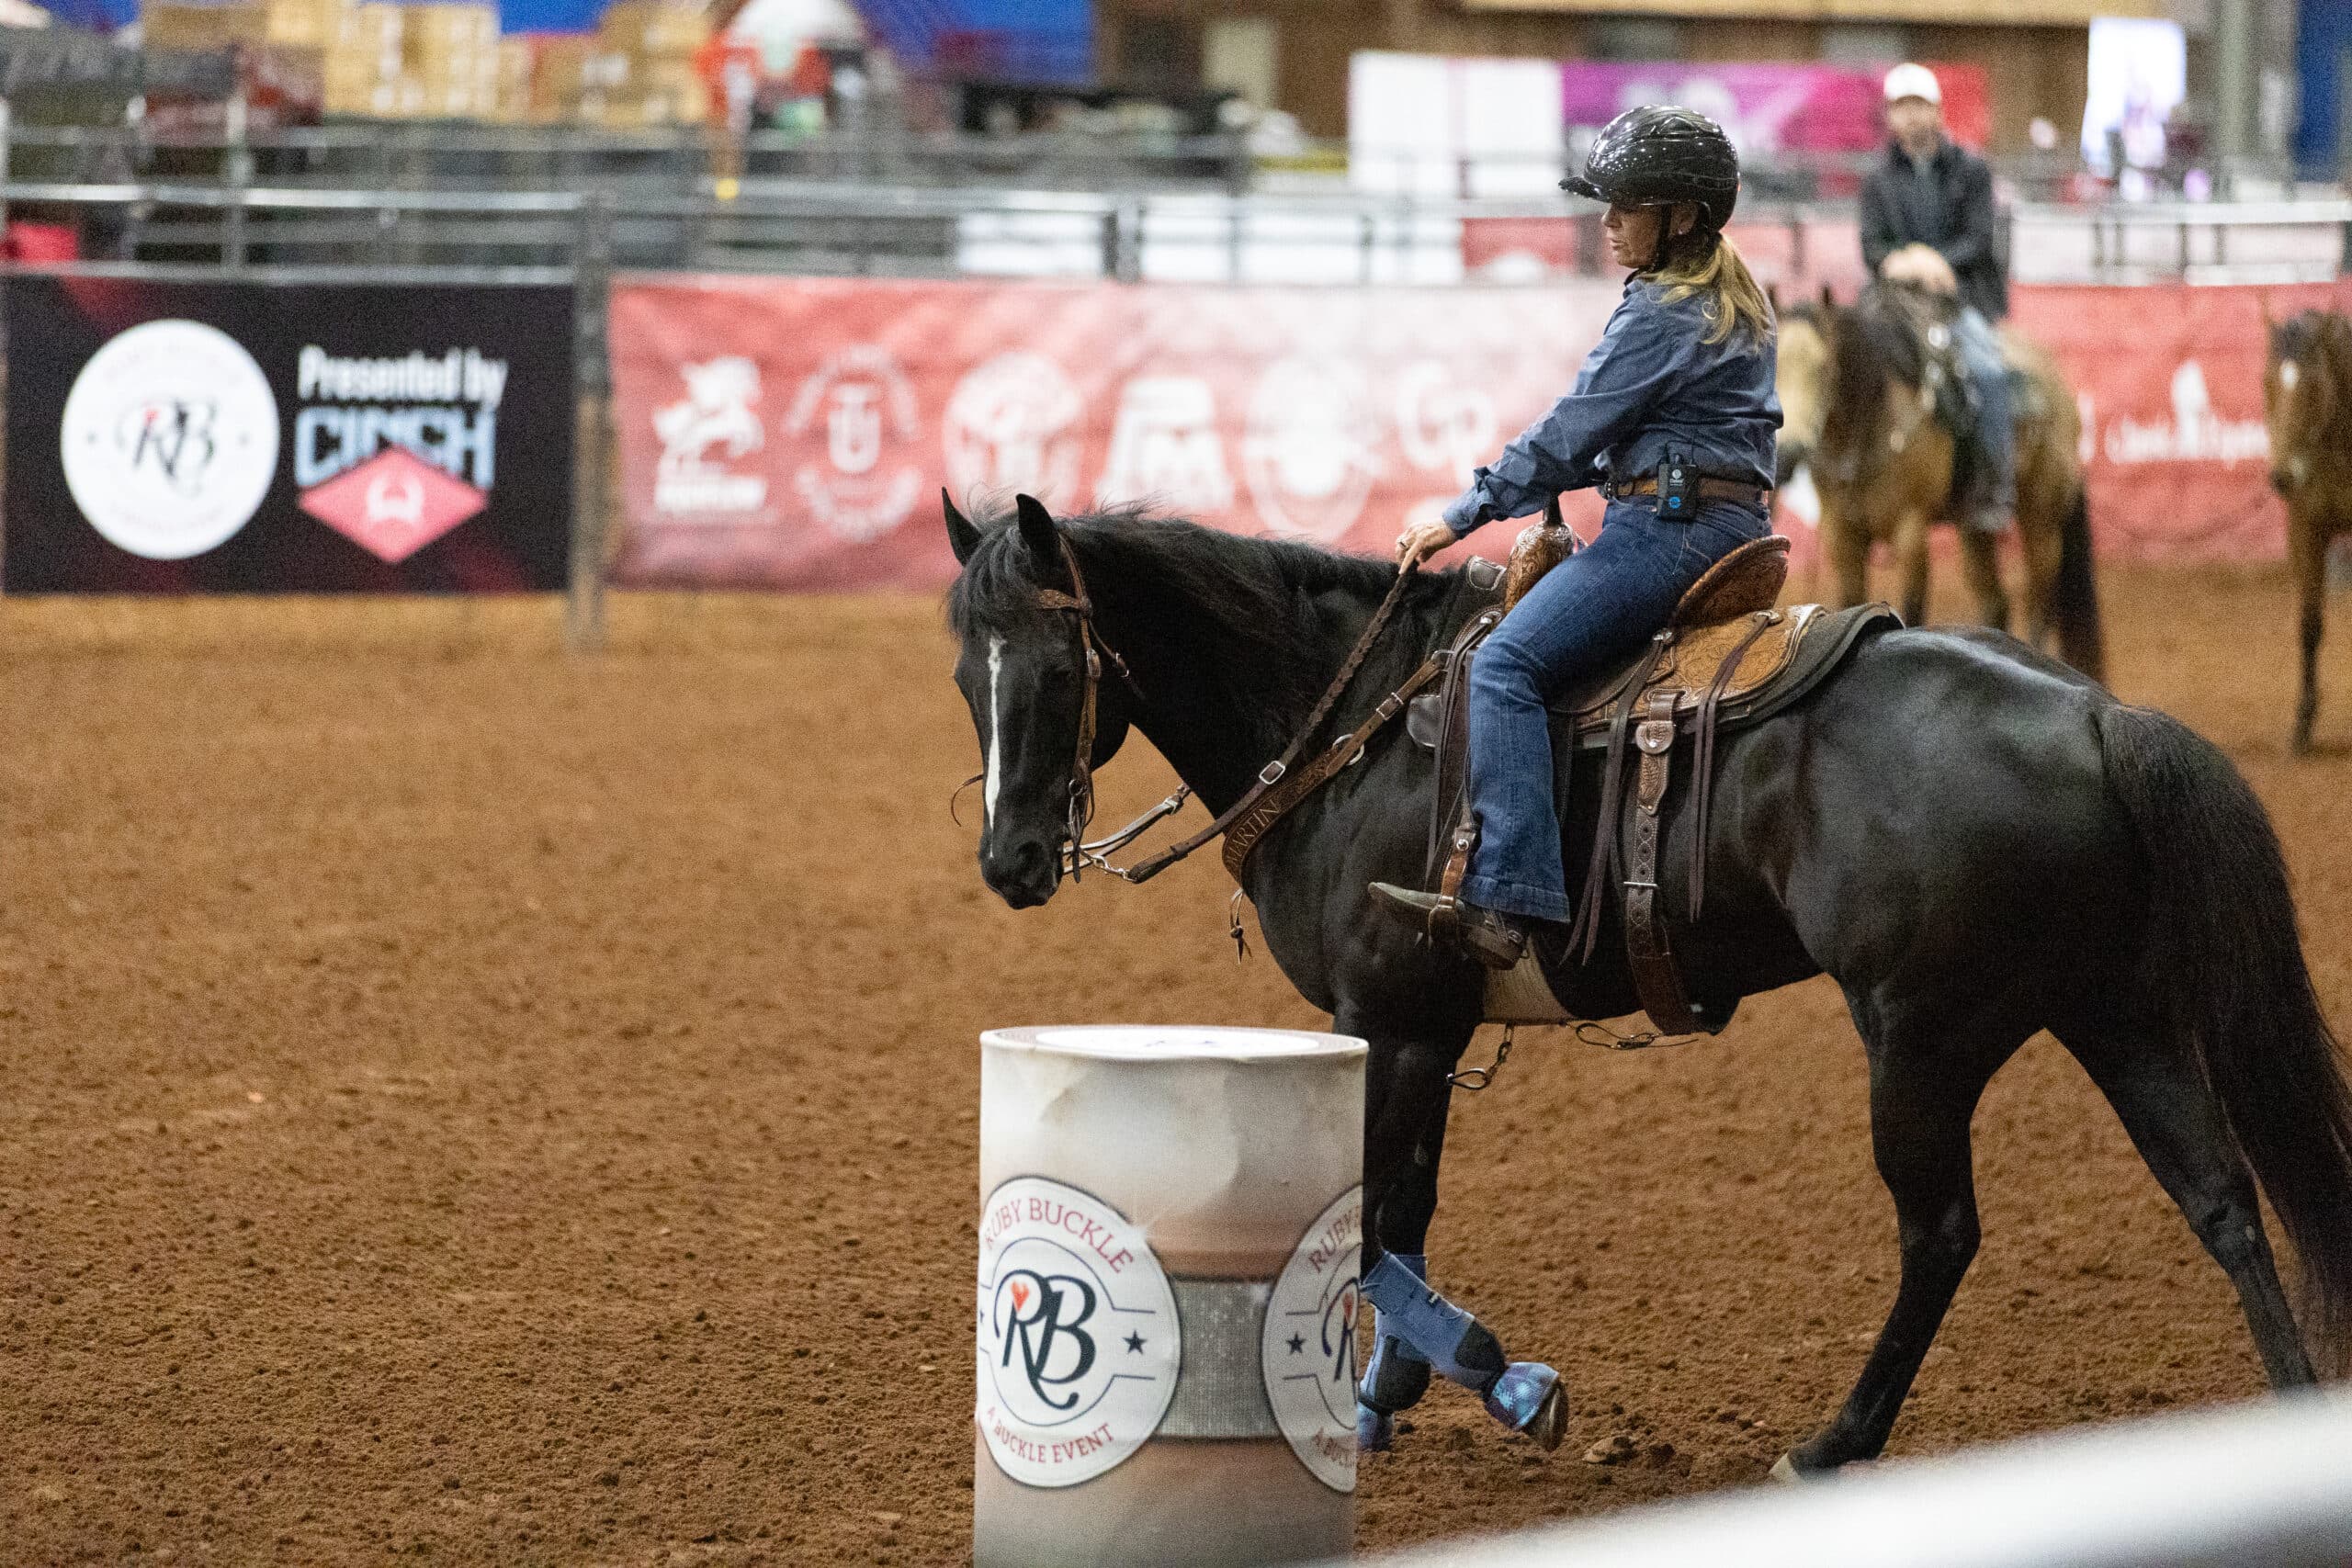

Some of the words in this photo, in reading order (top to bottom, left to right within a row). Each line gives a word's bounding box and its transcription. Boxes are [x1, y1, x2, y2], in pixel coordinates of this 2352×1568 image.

[298, 345, 460, 400] Presented
[462, 347, 508, 409] by
[985, 1199, 1022, 1249] RUBY
[1029, 1197, 1134, 1274] BUCKLE
[1308, 1209, 1352, 1274] RUBY
[993, 1418, 1046, 1463] BUCKLE
[1052, 1422, 1114, 1463] EVENT
